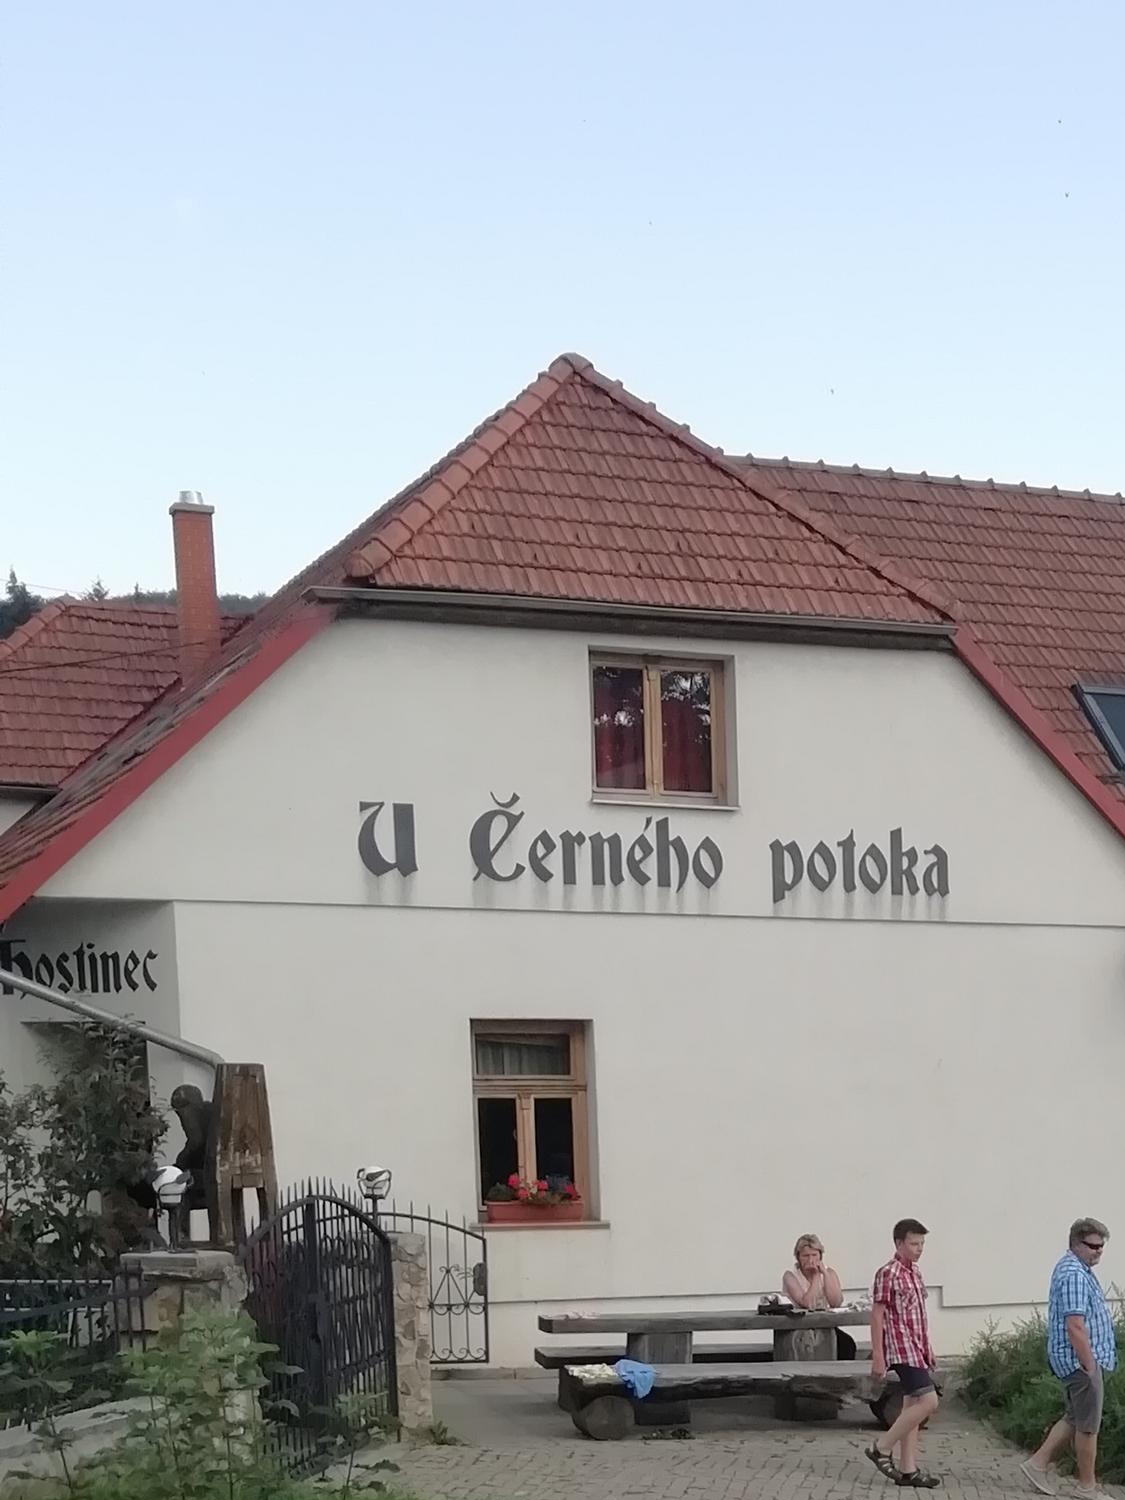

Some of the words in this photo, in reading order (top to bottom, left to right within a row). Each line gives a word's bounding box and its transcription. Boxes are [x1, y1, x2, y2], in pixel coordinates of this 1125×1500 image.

[357, 801, 419, 877] U
[469, 791, 724, 893] Černého
[768, 827, 951, 904] potoka
